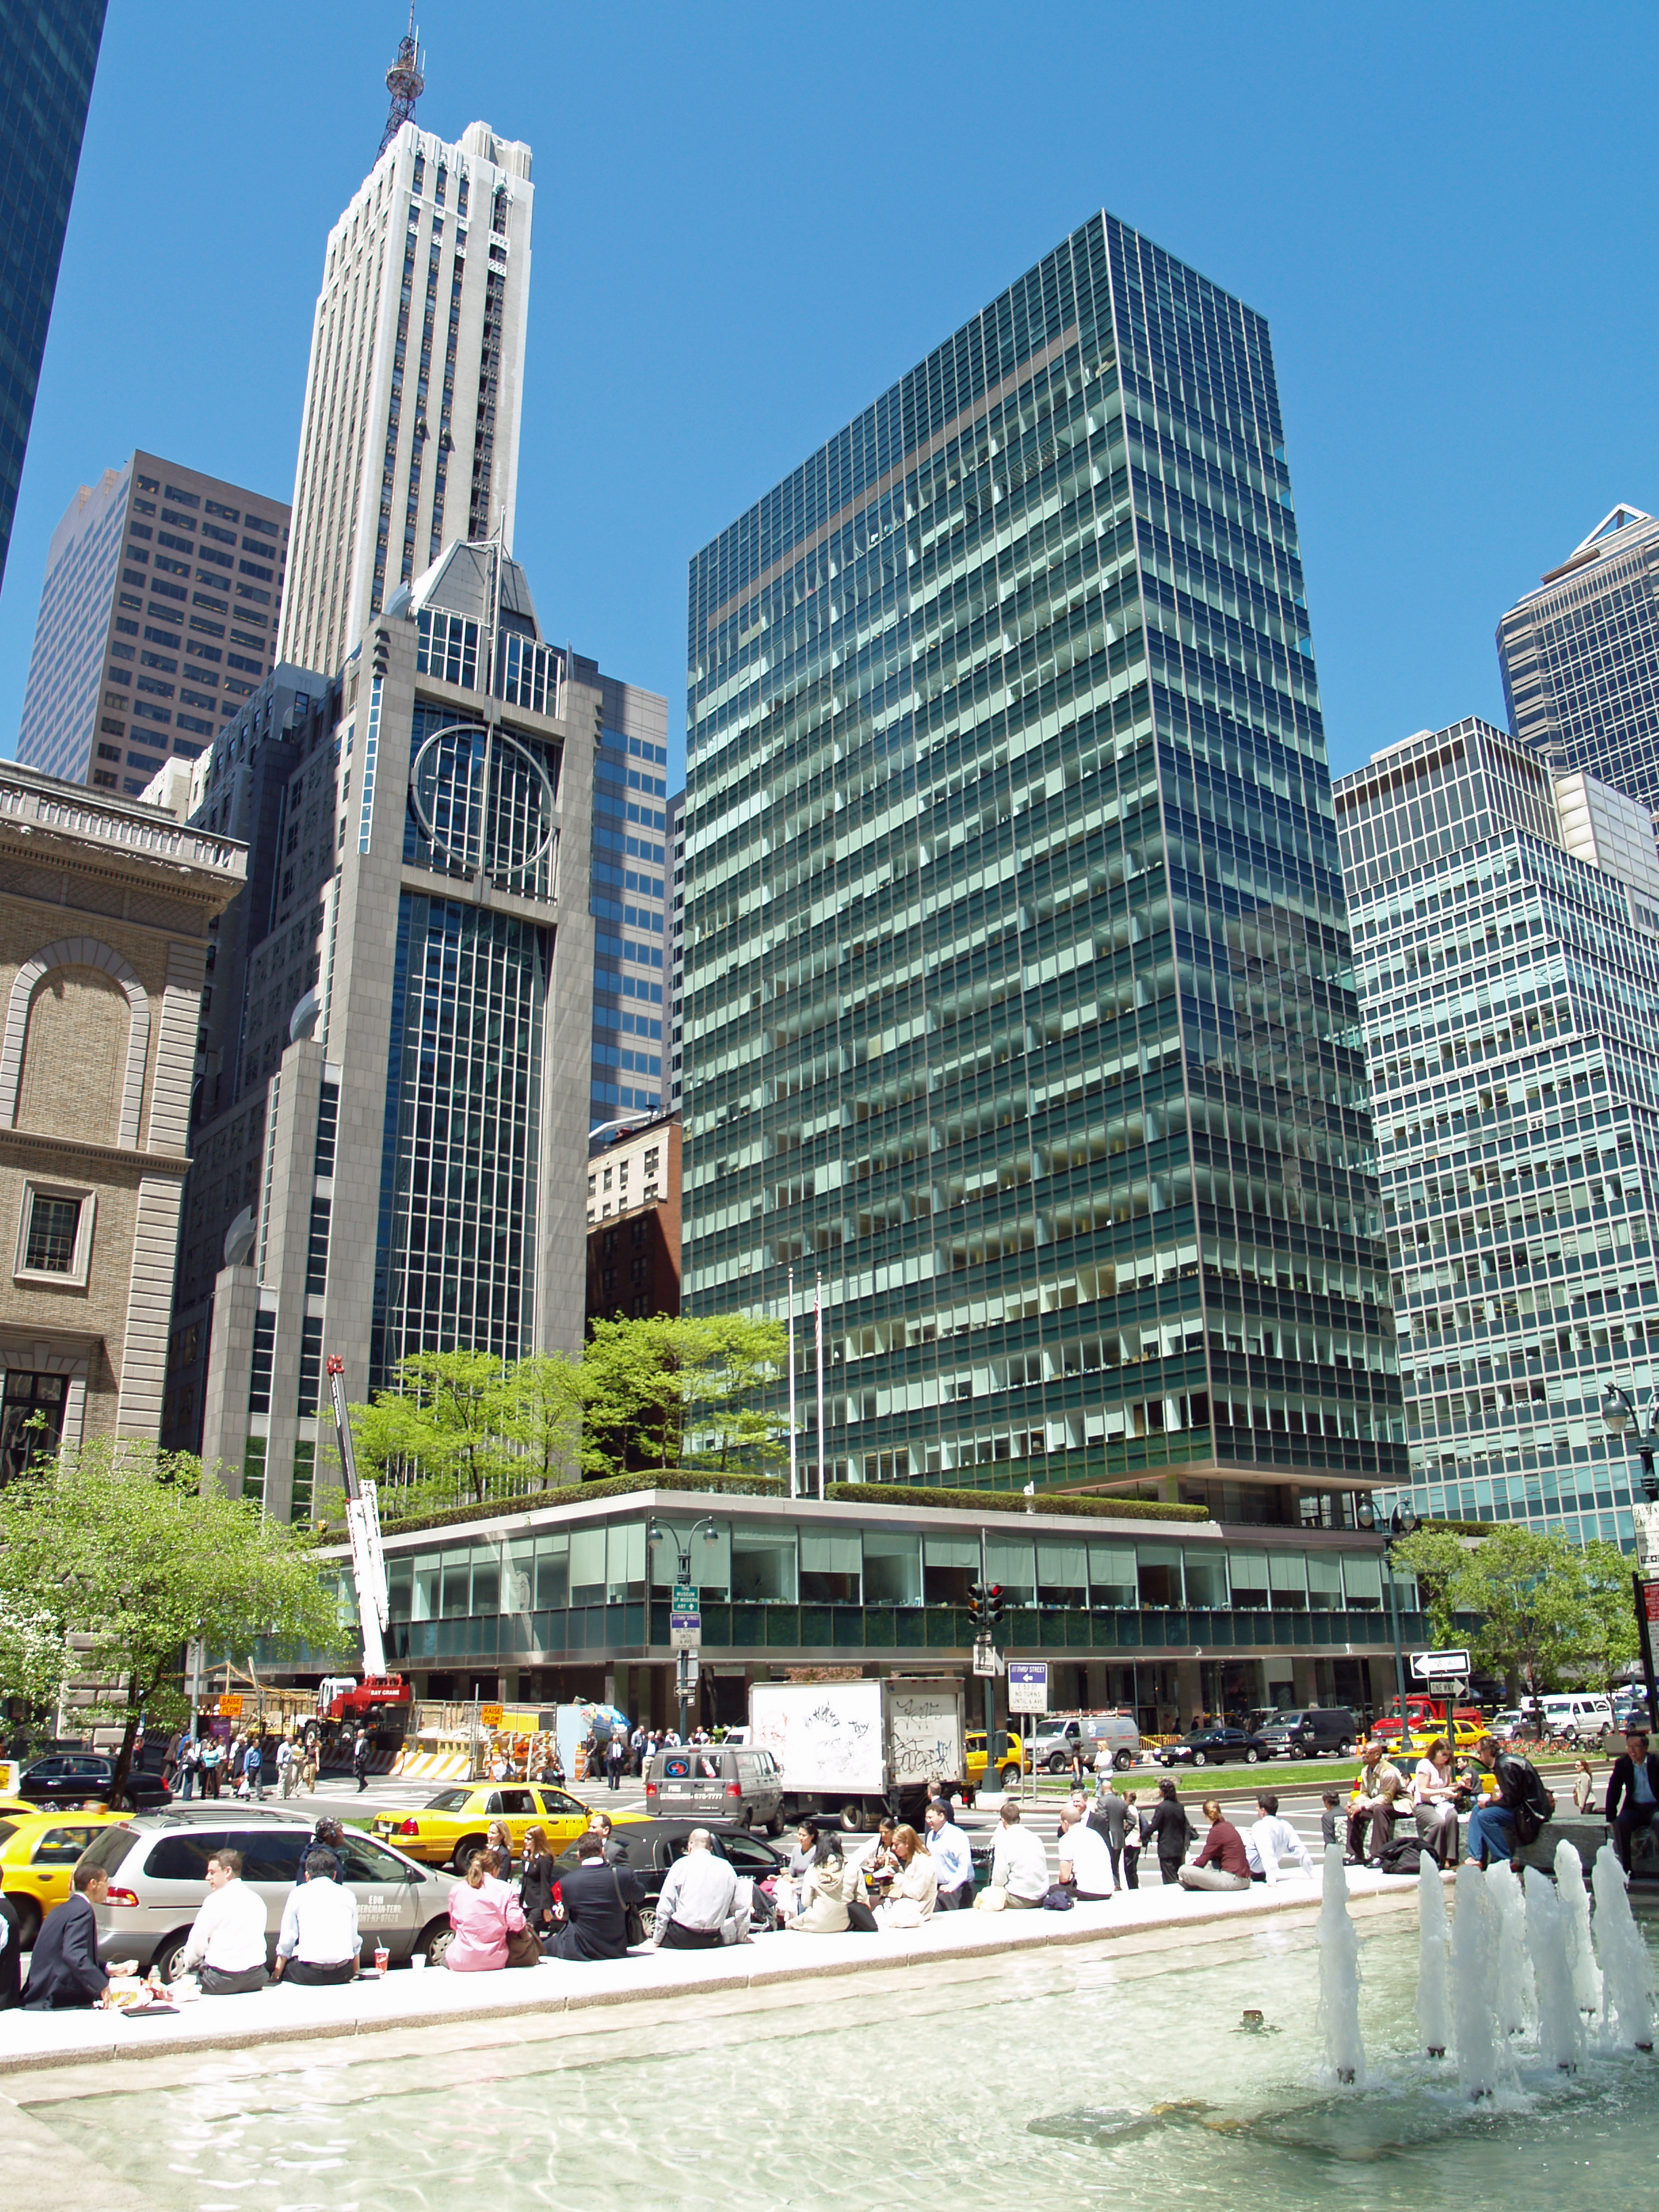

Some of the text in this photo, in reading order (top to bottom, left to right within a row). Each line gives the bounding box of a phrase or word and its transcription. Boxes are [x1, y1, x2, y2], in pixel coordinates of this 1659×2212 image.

[1635, 1517, 1651, 1529] CARS
[1431, 1682, 1454, 1693] ONE WAY
